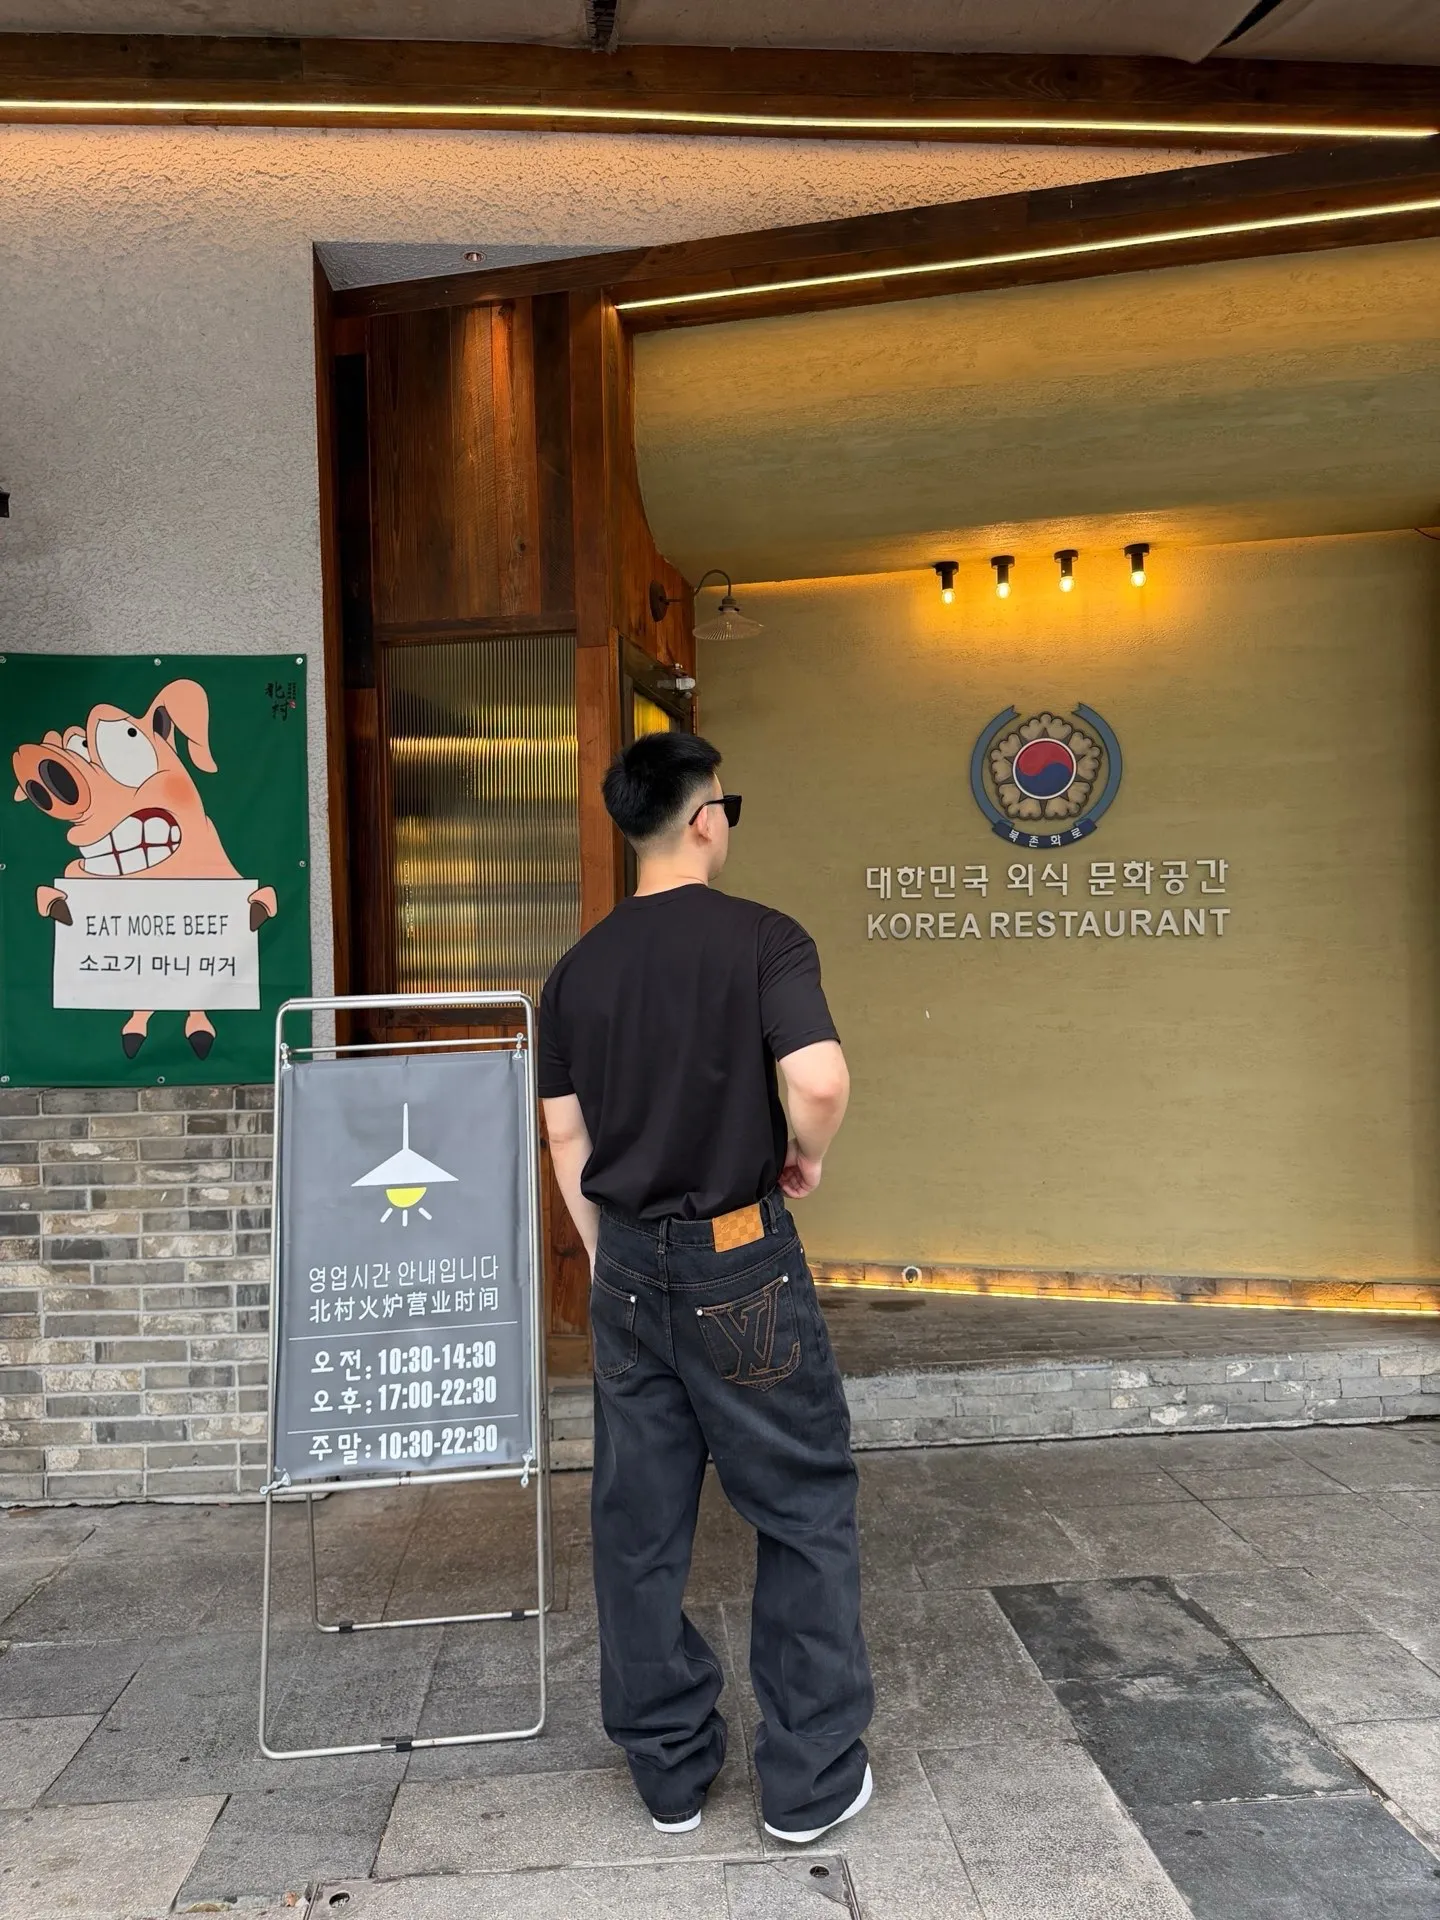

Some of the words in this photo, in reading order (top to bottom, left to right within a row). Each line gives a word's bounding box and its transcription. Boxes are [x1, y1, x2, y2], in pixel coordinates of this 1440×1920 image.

[866, 864, 989, 899] 대한민국
[1007, 863, 1068, 896] 외식
[1088, 858, 1229, 896] 문화공간
[86, 915, 121, 936] EAT
[128, 915, 176, 936] MORE
[183, 914, 229, 936] BEEF
[867, 912, 982, 939] KOREA
[990, 908, 1231, 938] RESTAURANT
[79, 954, 142, 976] 소고기
[152, 955, 190, 976] 마니
[199, 956, 236, 976] 머거
[308, 1262, 391, 1293] 영업시간
[398, 1254, 499, 1286] 안내입니다
[309, 1287, 499, 1323] 北村火炉营业时间
[378, 1340, 497, 1376] 10:30-14:30
[378, 1375, 497, 1411] 17:00-22:30
[378, 1424, 498, 1460] 10:30-22:30
